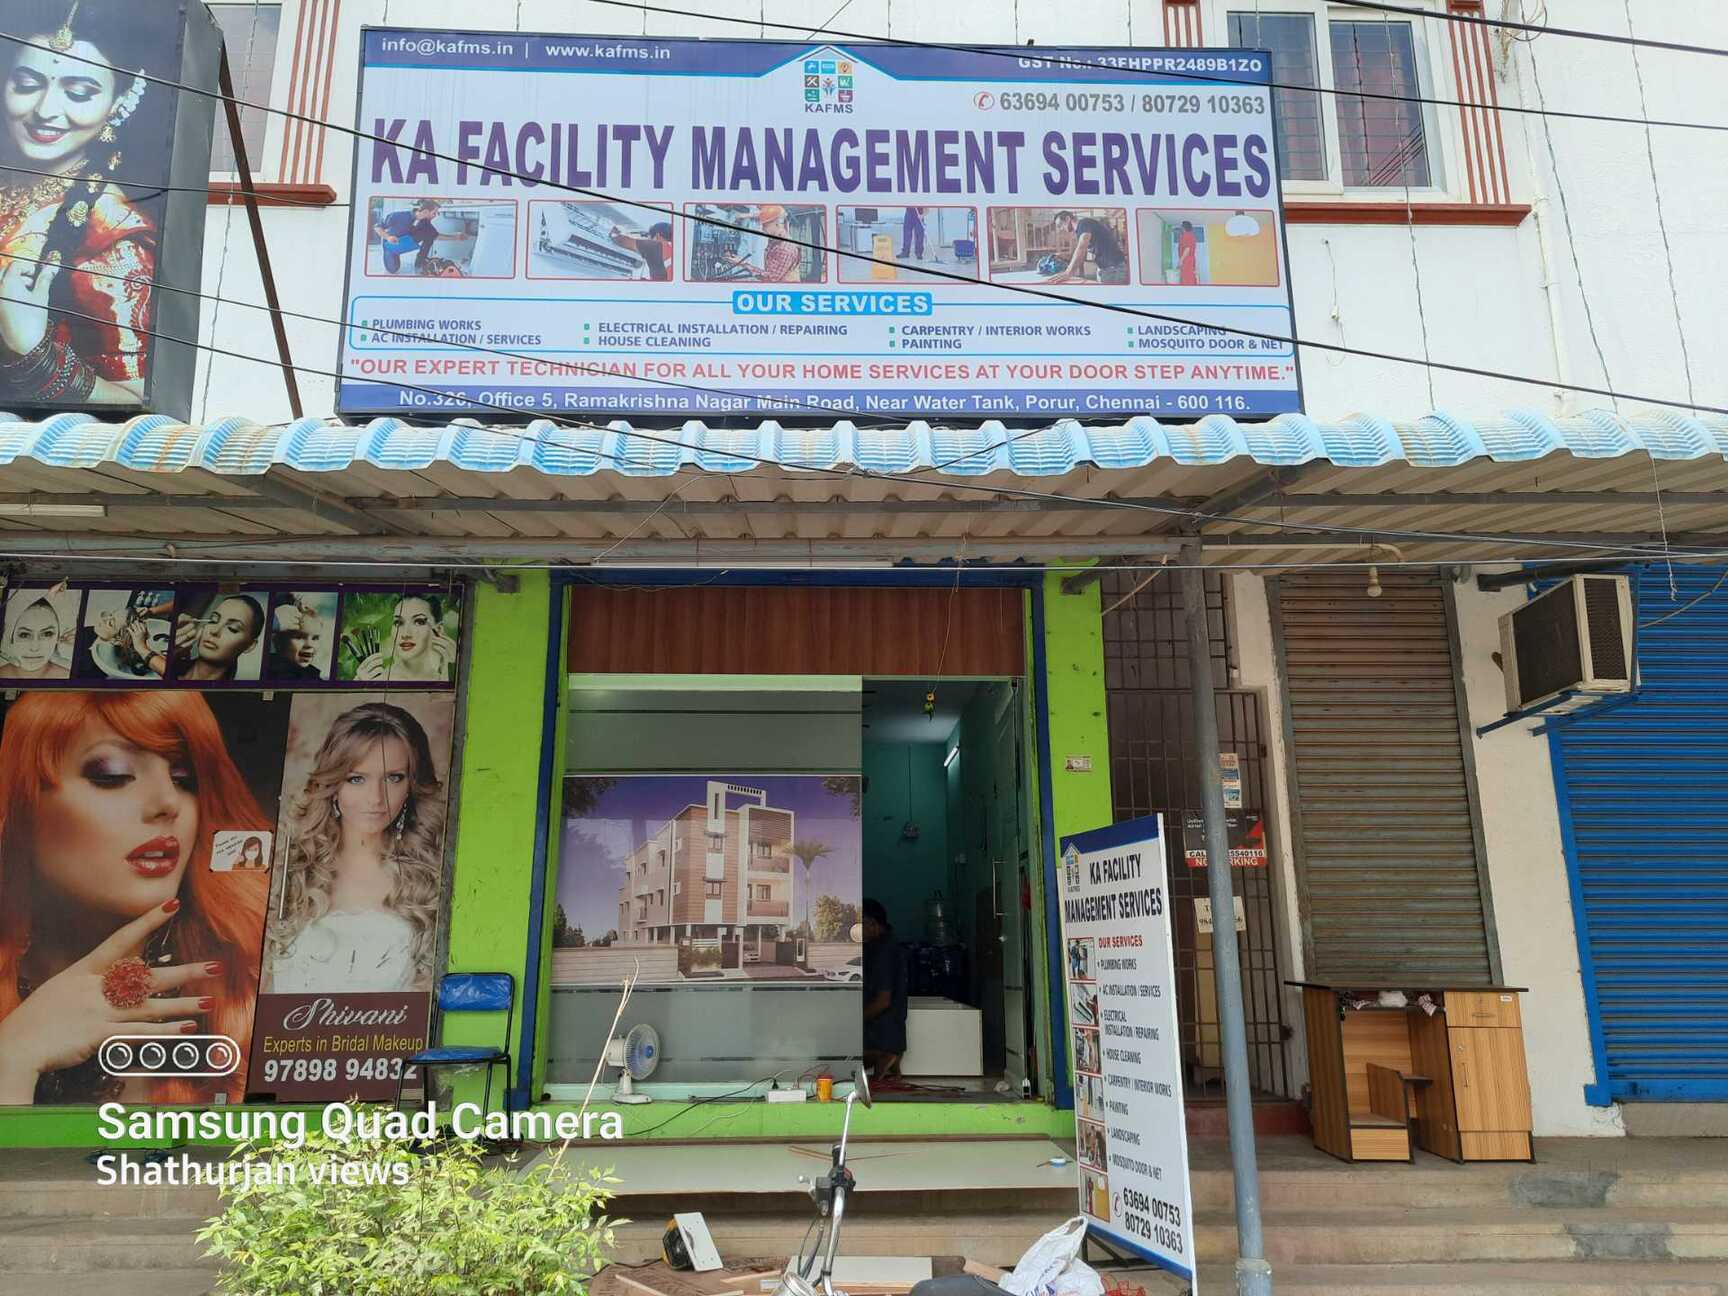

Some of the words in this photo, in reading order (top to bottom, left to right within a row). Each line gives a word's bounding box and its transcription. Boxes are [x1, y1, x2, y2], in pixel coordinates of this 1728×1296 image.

[381, 38, 513, 56] info@kafms.in
[545, 43, 671, 60] www.kafms.in
[1018, 56, 1054, 69] GST
[804, 103, 853, 114] KAFMS
[1000, 93, 1060, 112] 63694
[1066, 93, 1125, 113] 00753
[1142, 94, 1201, 114] 80729
[1207, 95, 1265, 115] 10363
[371, 117, 439, 185] KA
[456, 120, 675, 189] FACILITY
[691, 125, 1025, 194] MANAGEMENT
[1042, 131, 1271, 199] SERVICES
[737, 293, 793, 313] OUR
[800, 294, 929, 314] SERVICES
[372, 319, 435, 331] PLUMBING
[439, 320, 482, 331] WORKS
[598, 322, 674, 334] ELECTRICAL
[678, 323, 769, 335] INSTALLATION
[780, 324, 848, 336] REPAIRING
[902, 325, 974, 337] CARPENTRY
[986, 325, 1043, 337] INTERIOR
[1046, 326, 1091, 337] WORKS
[1138, 325, 1227, 336] LANDSCAPING
[371, 333, 389, 344] AC
[391, 333, 477, 345] INSTALLATION
[486, 334, 542, 346] SERVICES
[598, 335, 642, 347] HOUSE
[645, 336, 712, 348] CLEANING
[902, 339, 962, 350] PAINTING
[1138, 338, 1205, 350] MOSQUITO
[1209, 339, 1245, 349] DOOR
[1249, 339, 1257, 350] &
[414, 360, 500, 375] EXPERT
[507, 361, 636, 377] TECHNICIAN
[644, 362, 686, 378] FOR
[692, 364, 731, 378] ALL
[737, 364, 796, 379] YOUR
[803, 364, 862, 379] HOME
[869, 364, 970, 380] SERVICES
[975, 365, 999, 379] AT
[1006, 365, 1063, 380] YOUR
[1069, 365, 1128, 380] DOOR
[1134, 365, 1185, 380] STEP
[478, 391, 536, 407] Office
[542, 392, 557, 409] 5,
[564, 392, 689, 408] Ramakrishna
[696, 394, 750, 412] Nagar
[757, 394, 800, 409] Main
[807, 394, 860, 411] Road,
[866, 395, 909, 410] Near
[910, 395, 968, 410] Water
[971, 395, 1019, 411] Tank,
[1026, 395, 1079, 411] Porur,
[1085, 395, 1160, 410] Chennai
[1177, 395, 1209, 410] 600
[1215, 396, 1251, 410] 116.
[1089, 861, 1102, 885] KA
[1103, 853, 1141, 883] FACILITY
[1065, 894, 1117, 923] MANAGEMENT
[1119, 887, 1162, 920] SERVICES
[1098, 937, 1112, 949] OUR
[1112, 935, 1143, 948] SERVICES
[1122, 959, 1137, 970] WORKS
[1109, 985, 1137, 997] INSTALLATION
[1140, 984, 1161, 997] SERVICES
[283, 998, 409, 1031] Shivani
[1103, 1010, 1127, 1022] ELECTRICAL
[1135, 1027, 1159, 1040] REPAIRING
[263, 1036, 312, 1055] Experts
[316, 1035, 327, 1051] in
[331, 1035, 369, 1052] Bridal
[373, 1034, 423, 1055] Makeup
[1106, 1048, 1120, 1061] HOUSE
[264, 1058, 337, 1082] 97898
[345, 1057, 417, 1081] 94832
[1154, 1082, 1172, 1097] WORKS
[1109, 1100, 1129, 1115] PAINTING
[1111, 1128, 1141, 1146] LANDSCAPING
[1135, 1160, 1148, 1175] DOOR
[1153, 1166, 1162, 1181] NET
[1123, 1187, 1150, 1215] 63694
[1151, 1198, 1181, 1227] 00753
[1124, 1211, 1151, 1240] 80729
[1154, 1223, 1183, 1254] 10363
